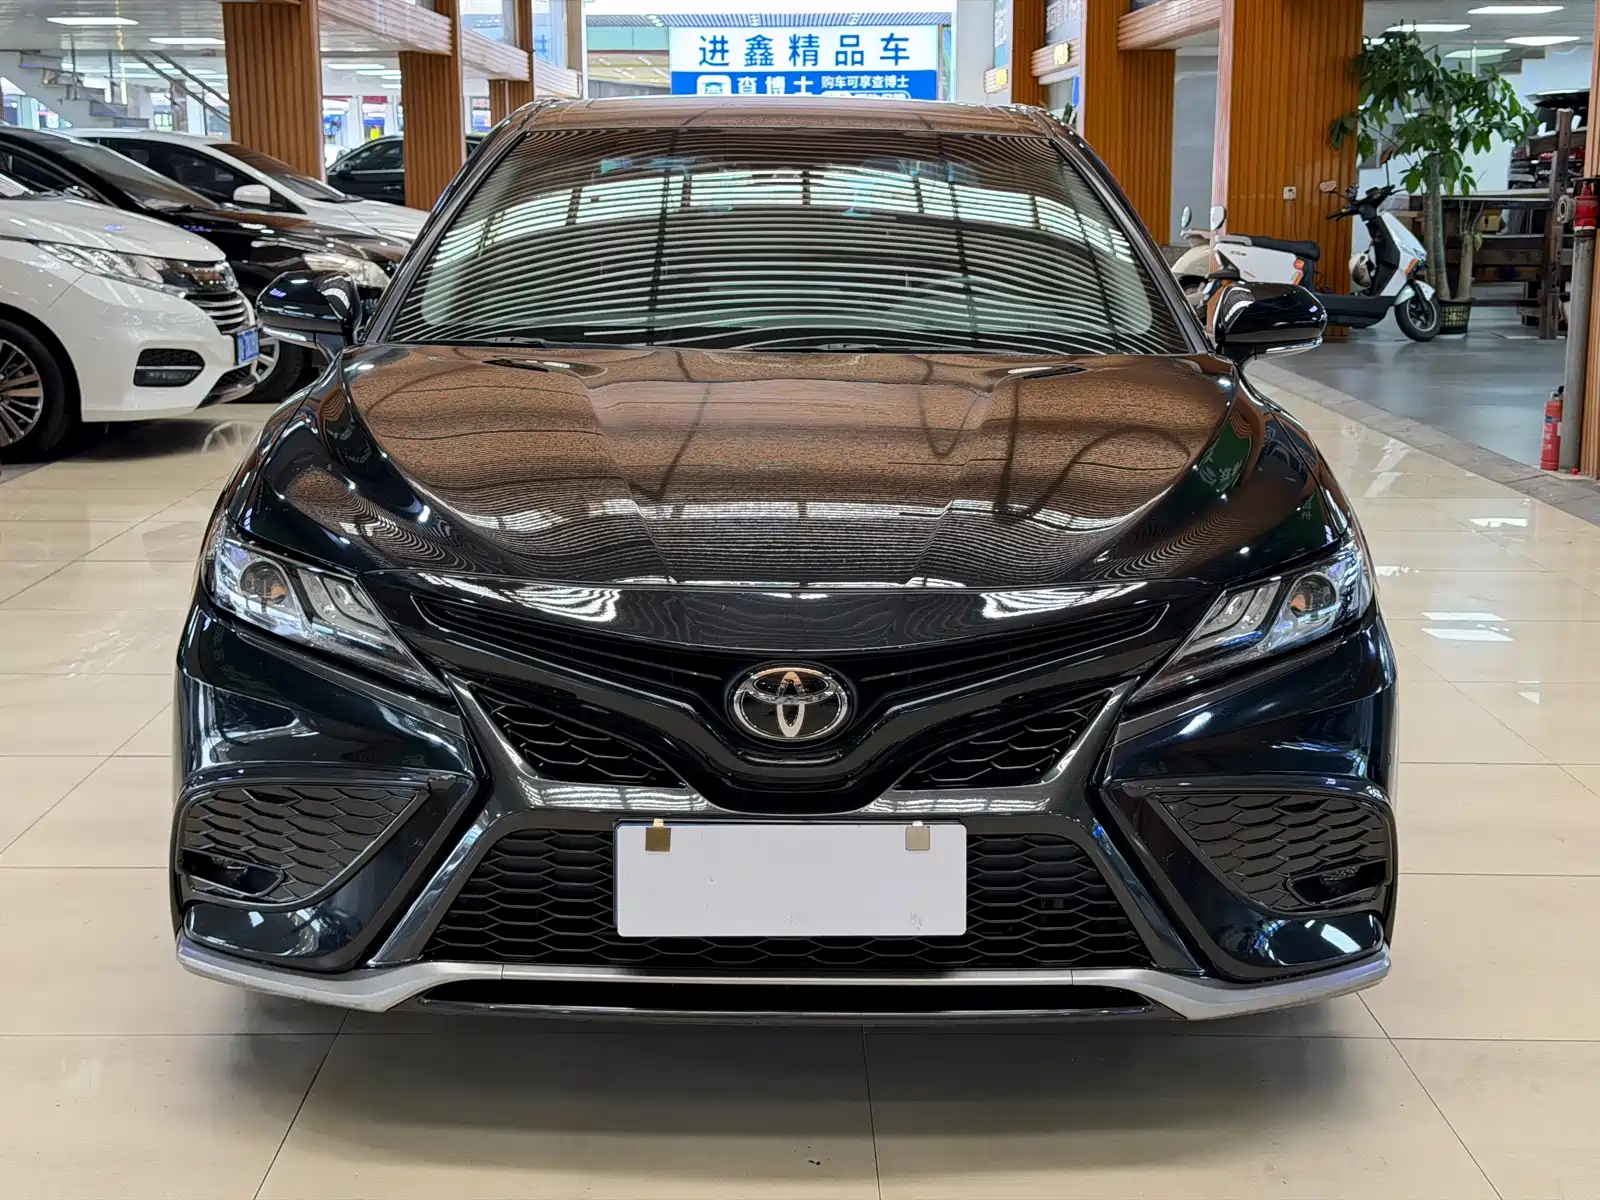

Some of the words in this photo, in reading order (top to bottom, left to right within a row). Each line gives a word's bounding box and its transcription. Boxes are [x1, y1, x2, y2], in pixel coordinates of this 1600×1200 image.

[698, 33, 910, 67] 进鑫精品车
[821, 75, 910, 89] 购车可享查博士
